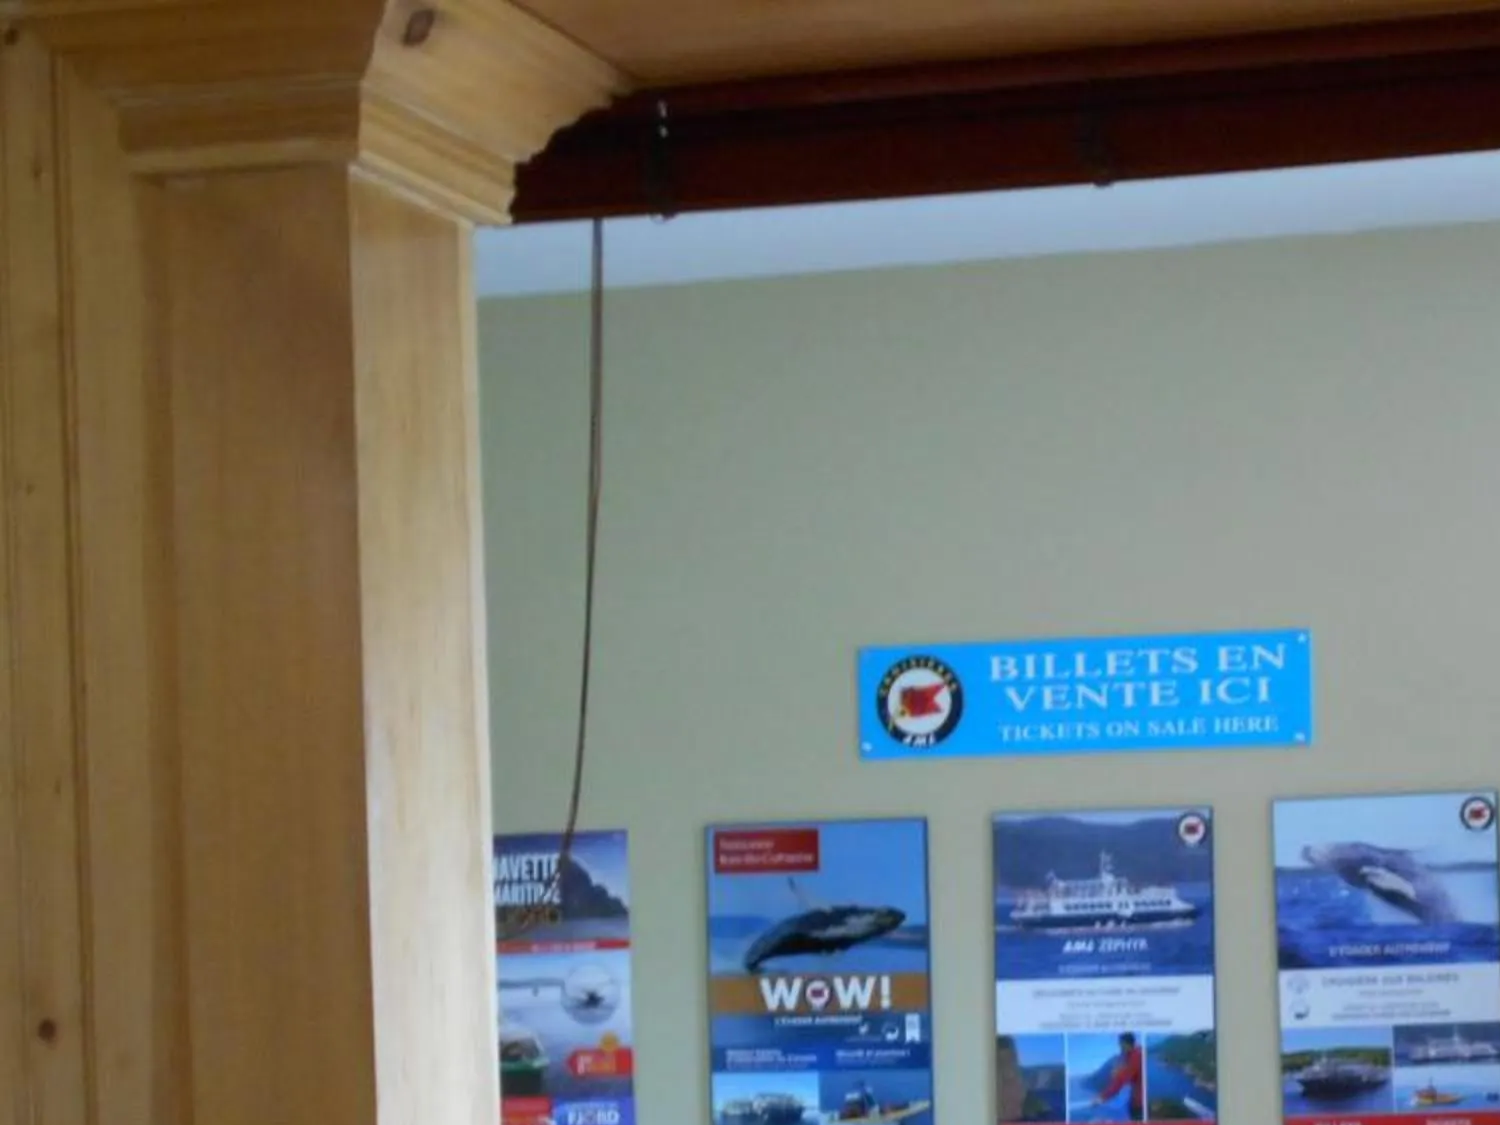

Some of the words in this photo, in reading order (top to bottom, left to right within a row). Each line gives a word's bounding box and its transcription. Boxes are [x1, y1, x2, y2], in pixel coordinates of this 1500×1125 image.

[989, 647, 1199, 682] BILLETS
[1217, 643, 1287, 672] EN
[1004, 679, 1181, 711] VENTE
[1200, 676, 1272, 705] ICI
[1000, 721, 1100, 742] TICKETS
[1106, 720, 1140, 738] ON
[1148, 717, 1206, 736] SALE
[1214, 715, 1279, 733] HERE
